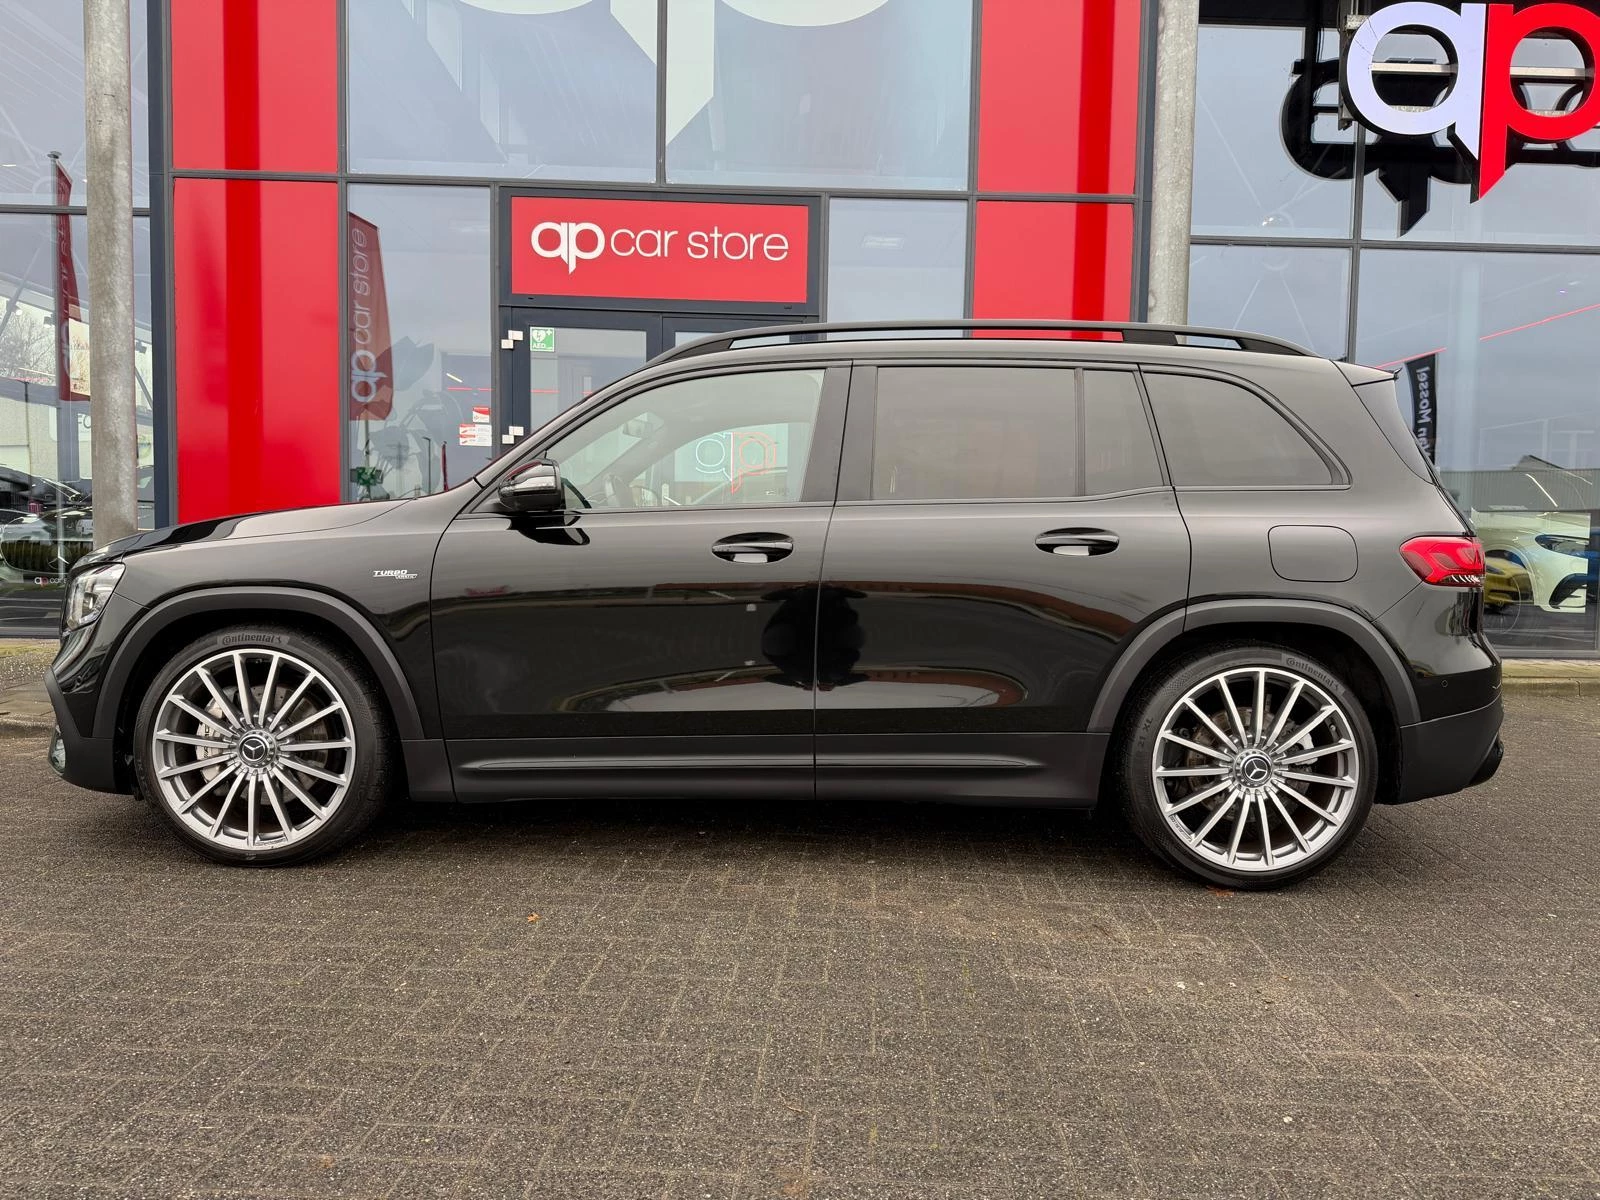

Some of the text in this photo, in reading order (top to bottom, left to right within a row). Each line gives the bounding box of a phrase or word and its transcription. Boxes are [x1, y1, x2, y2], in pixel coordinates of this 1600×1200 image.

[530, 221, 789, 275] ap car store
[350, 228, 388, 403] ap car store
[222, 633, 275, 646] Continental
[1286, 657, 1335, 687] Continental
